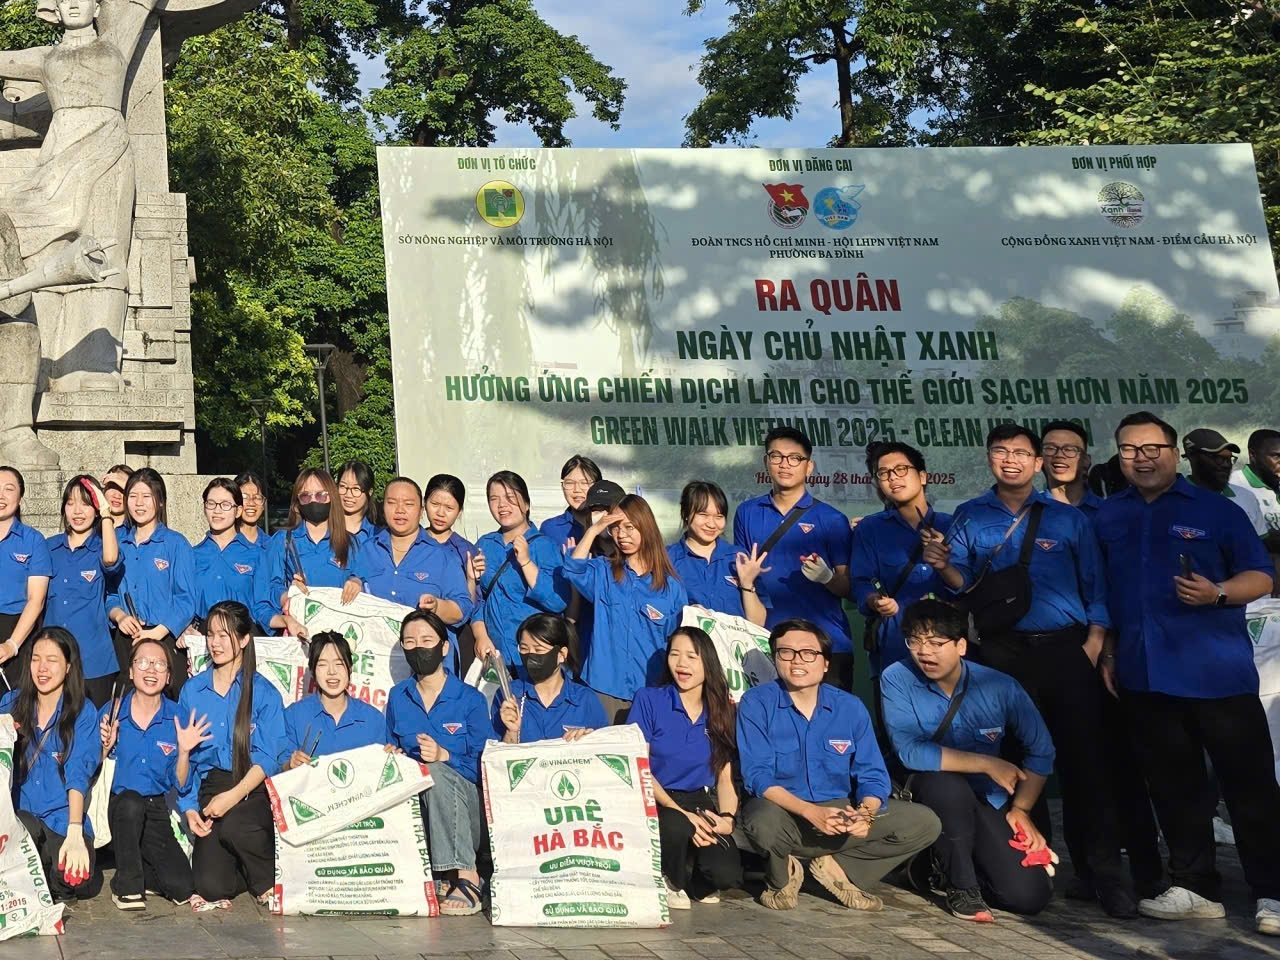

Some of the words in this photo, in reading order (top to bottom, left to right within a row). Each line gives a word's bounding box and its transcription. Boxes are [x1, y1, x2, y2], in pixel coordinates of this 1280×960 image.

[457, 157, 479, 170] ĐƠN
[481, 158, 492, 173] VỊ
[493, 154, 506, 170] TỔ
[508, 155, 536, 170] CHỨC
[769, 158, 790, 172] ĐƠN
[793, 159, 804, 175] VỊ
[805, 156, 833, 172] ĐĂNG
[836, 159, 853, 172] CAI
[1072, 156, 1094, 170] ĐƠN
[1096, 156, 1107, 172] VỊ
[1109, 153, 1134, 169] PHỐI
[1136, 155, 1157, 170] HỢP
[398, 233, 413, 245] SỞ
[414, 234, 445, 245] NÔNG
[447, 235, 488, 247] NGHIỆP
[489, 234, 505, 246] VÀ
[506, 234, 529, 246] MÔI
[529, 234, 573, 246] TRƯỜNG
[575, 234, 592, 246] HÀ
[593, 234, 613, 248] NỘI
[692, 235, 723, 247] ĐOÀN
[726, 237, 753, 247] TNCS
[755, 234, 771, 247] HỒ
[772, 236, 792, 247] CHÍ
[794, 237, 825, 247] MINH
[833, 235, 854, 248] HỘI
[855, 237, 885, 247] LHPN
[887, 236, 912, 248] VIỆT
[913, 237, 939, 247] NAM
[1001, 235, 1033, 248] CỘNG
[1034, 233, 1066, 246] ĐỒNG
[1068, 236, 1100, 246] XANH
[1101, 235, 1126, 247] VIỆT
[1128, 236, 1154, 246] NAM
[1163, 233, 1192, 245] ĐIỂM
[1193, 232, 1216, 244] CẦU
[1218, 233, 1234, 245] HÀ
[1236, 234, 1257, 246] NỘI
[770, 248, 816, 259] PHƯỜNG
[818, 249, 833, 259] BA
[835, 247, 864, 259] ĐÌNH
[755, 279, 800, 312] RA
[809, 272, 901, 315] QUÂN
[676, 324, 753, 361] NGÀY
[765, 318, 821, 361] CHỦ
[831, 324, 907, 367] NHẬT
[915, 330, 998, 361] XANH
[445, 364, 531, 401] HƯỞNG
[539, 368, 590, 402] ỨNG
[597, 368, 673, 403] CHIẾN
[681, 377, 740, 409] DỊCH
[748, 371, 802, 404] LÀM
[809, 378, 860, 404] CHO
[867, 369, 914, 404] THẾ
[922, 373, 974, 404] GIỚI
[982, 378, 1051, 410] SẠCH
[1056, 375, 1112, 404] HƠN
[1120, 372, 1179, 404] NĂM
[1186, 377, 1249, 404] 2025
[590, 415, 659, 446] GREEN
[663, 416, 729, 446] WALK
[837, 416, 897, 447] 2025
[914, 416, 983, 447] CLEAN
[833, 473, 848, 485] 28
[926, 473, 956, 485] 2025
[549, 758, 591, 766] VINACHEM
[533, 828, 566, 855] HÀ
[573, 823, 624, 852] BẮC
